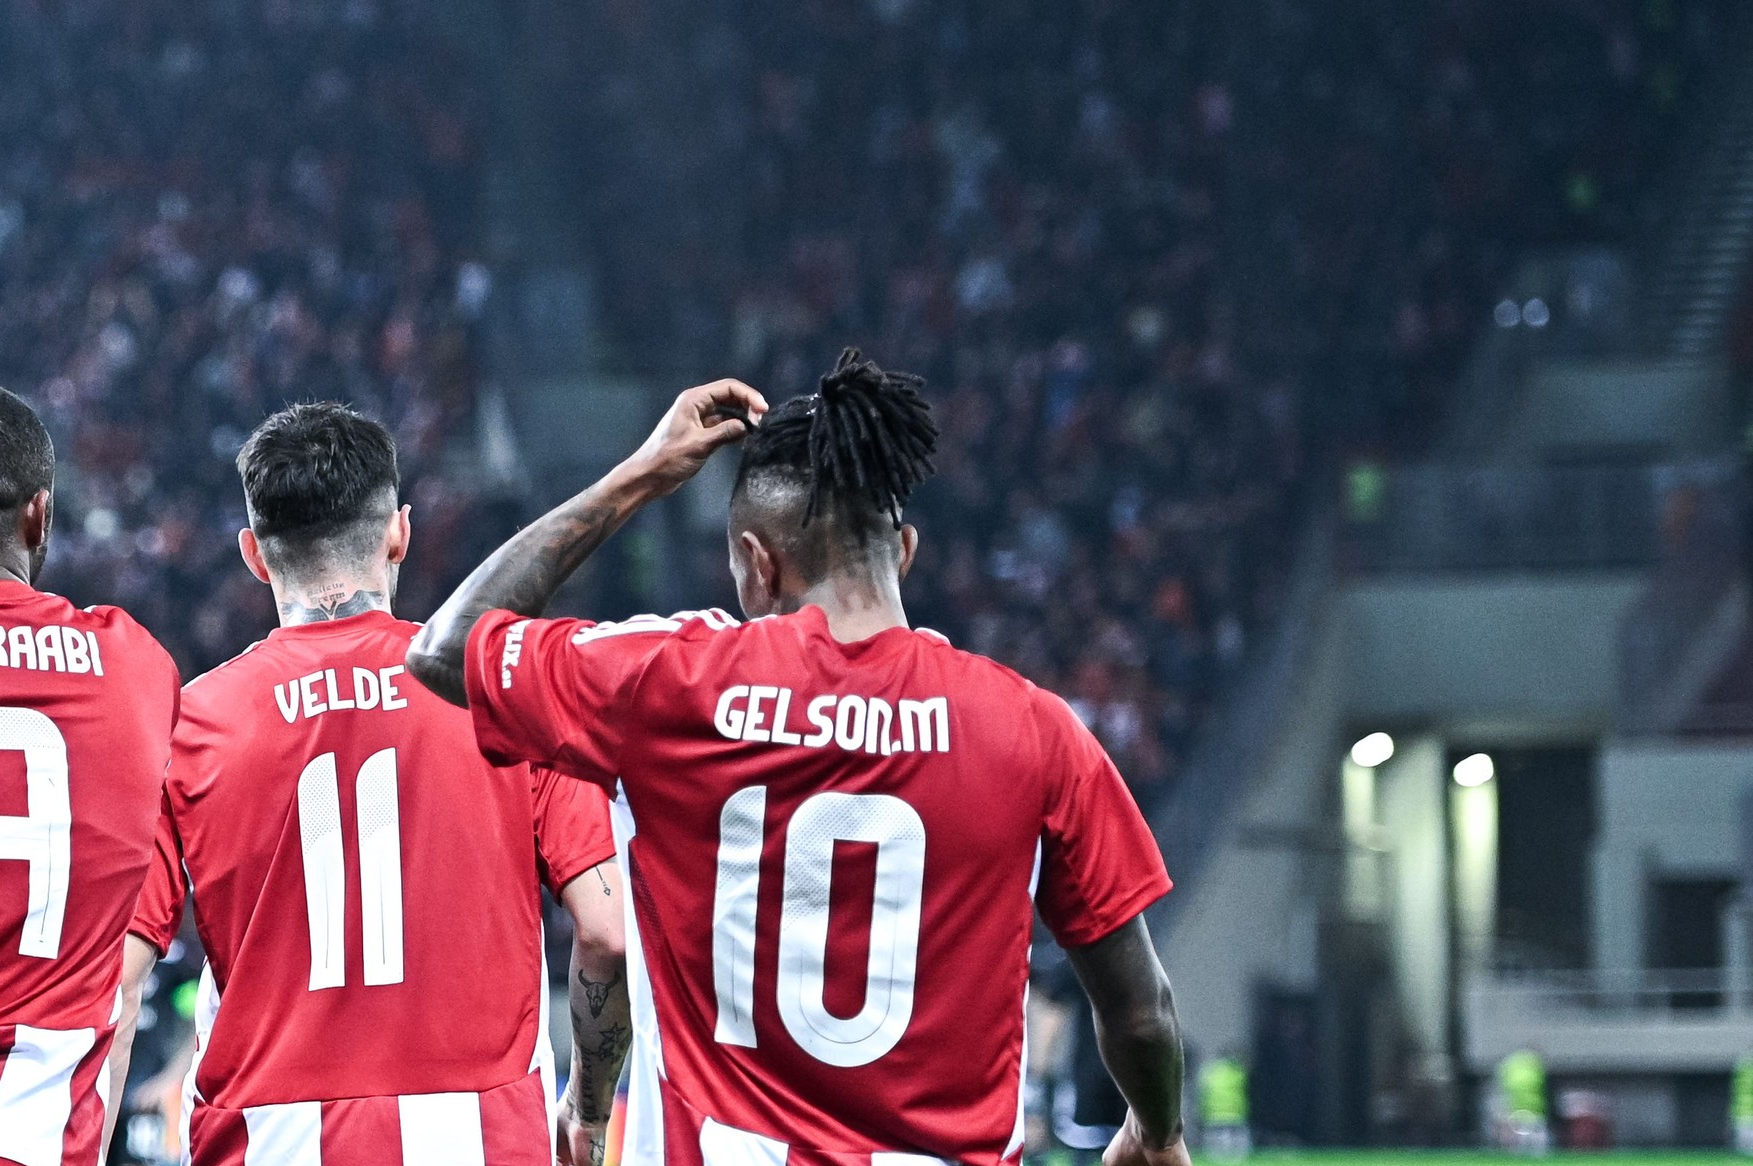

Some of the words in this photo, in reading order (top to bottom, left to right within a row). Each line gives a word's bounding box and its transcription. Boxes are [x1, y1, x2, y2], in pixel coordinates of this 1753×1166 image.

[273, 663, 408, 724] VELDE
[297, 747, 404, 992] 11
[712, 785, 926, 1068] 10
